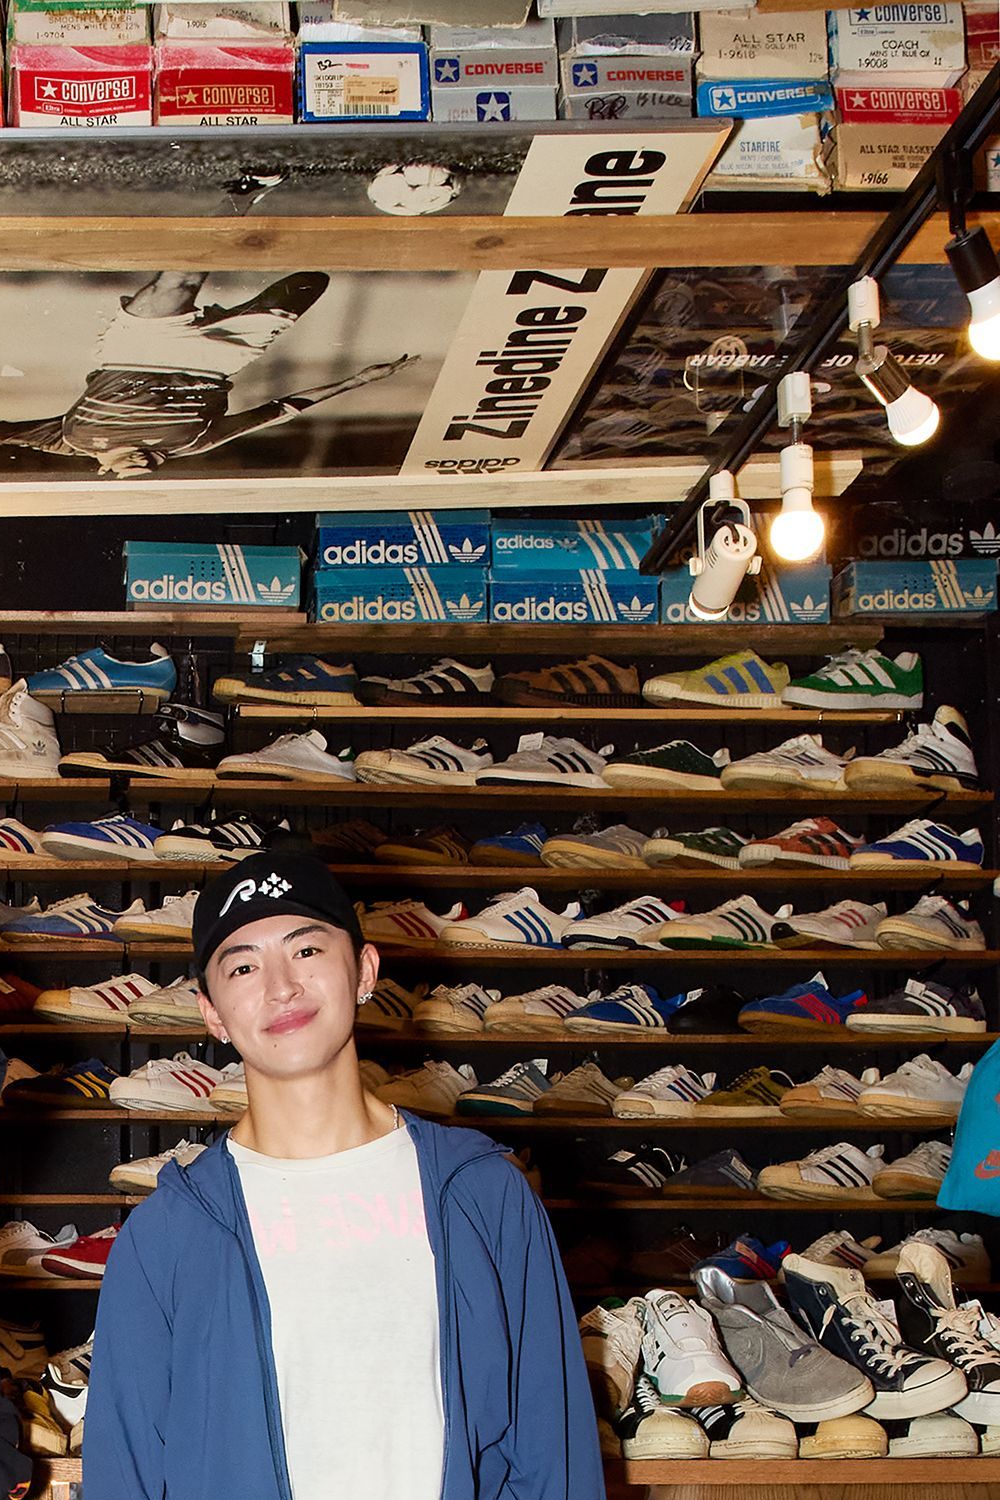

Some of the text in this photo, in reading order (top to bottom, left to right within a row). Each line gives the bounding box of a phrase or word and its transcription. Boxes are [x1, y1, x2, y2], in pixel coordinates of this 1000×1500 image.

[733, 32, 806, 43] ALL STAR
[881, 40, 919, 49] COACH
[464, 62, 544, 76] CONVERSE
[858, 58, 889, 69] 1-9008
[606, 69, 685, 82] CONVERSE
[737, 86, 815, 104] CONVERSE
[60, 115, 118, 127] ALL STAR
[200, 116, 258, 126] ALL STAR
[740, 141, 781, 153] STARFIRE
[860, 145, 937, 154] ALL STAR BASKET
[860, 173, 889, 185] 1-9166
[689, 354, 775, 367] JABBAR
[820, 354, 853, 367] OF
[442, 306, 588, 442] Zinedine
[423, 457, 521, 470] adidas
[496, 534, 555, 550] adidas
[858, 528, 964, 557] adidas
[323, 539, 418, 565] adidas
[130, 574, 227, 601] adidas
[858, 588, 936, 610] adidas
[320, 595, 416, 621] adidas
[493, 597, 588, 622] adidas
